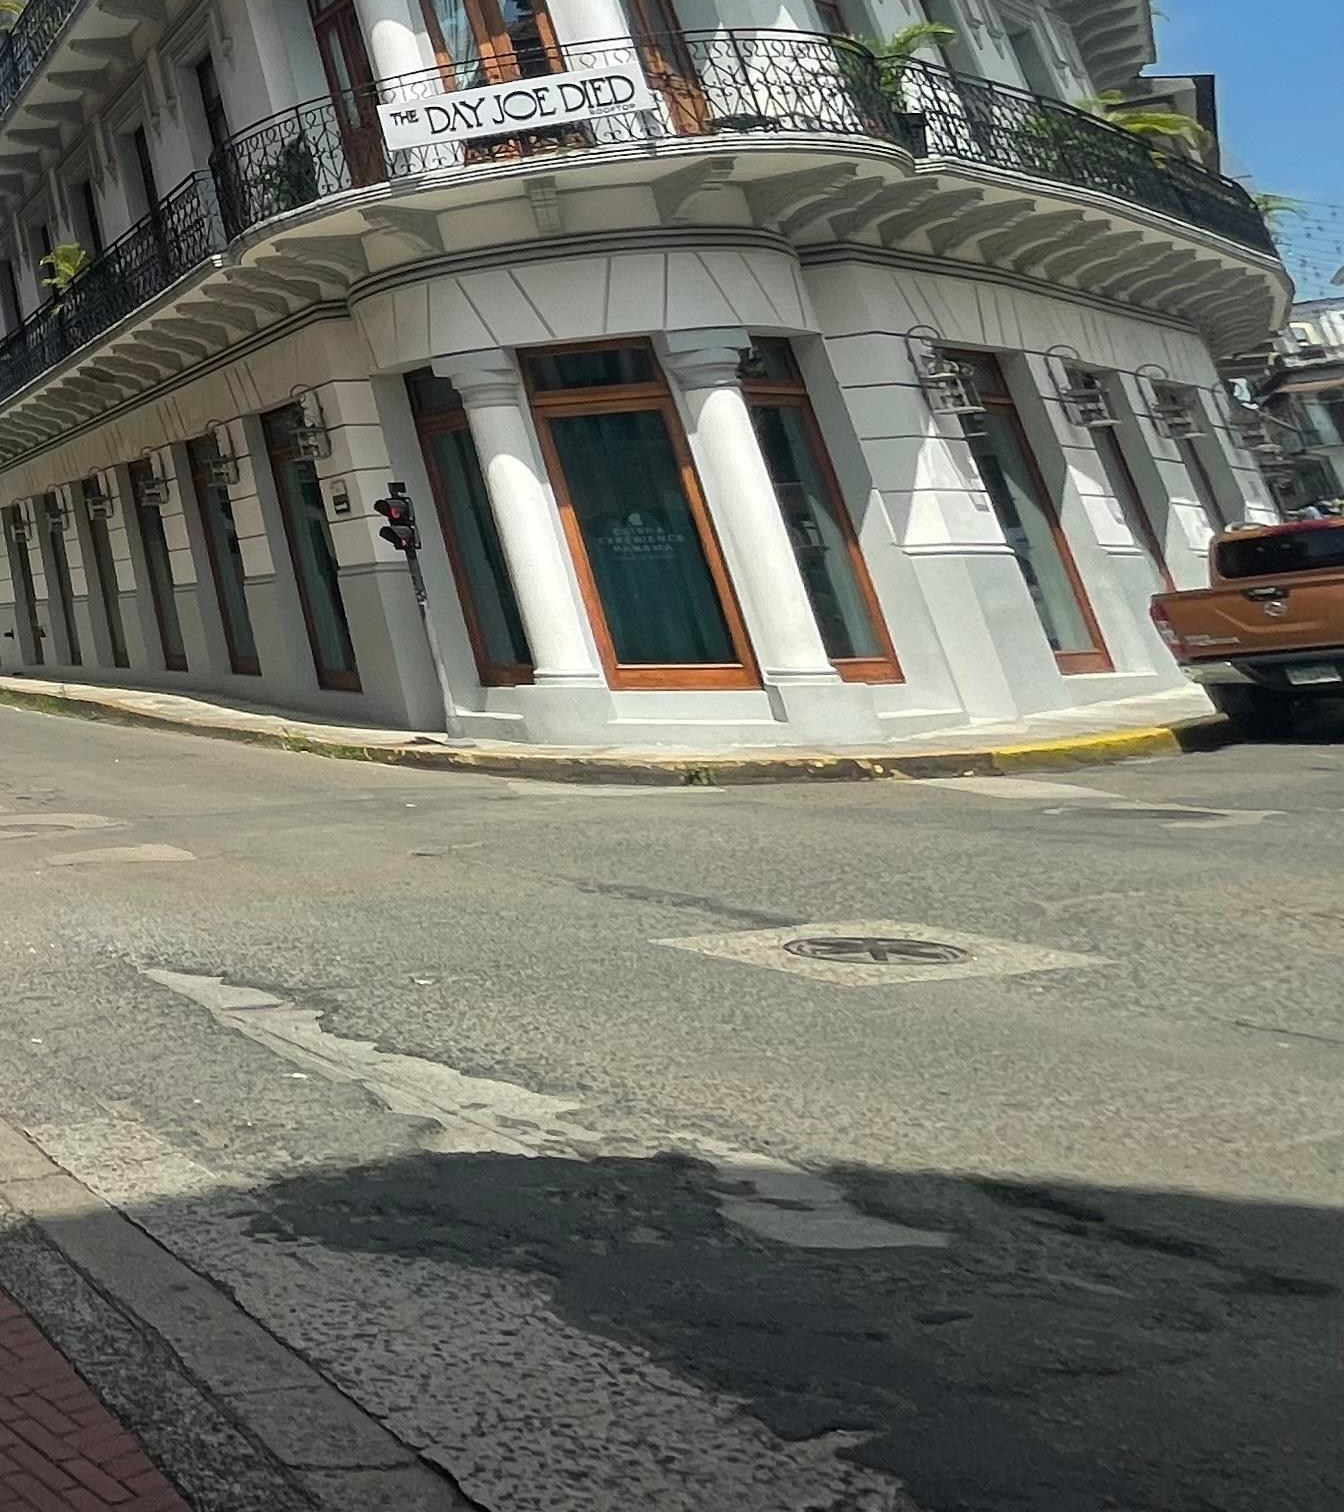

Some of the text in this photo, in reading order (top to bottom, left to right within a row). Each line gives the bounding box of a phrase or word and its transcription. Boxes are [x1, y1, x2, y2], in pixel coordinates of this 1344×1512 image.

[390, 74, 635, 135] THE DAY JOE DIED
[589, 103, 636, 115] ROOFTOP
